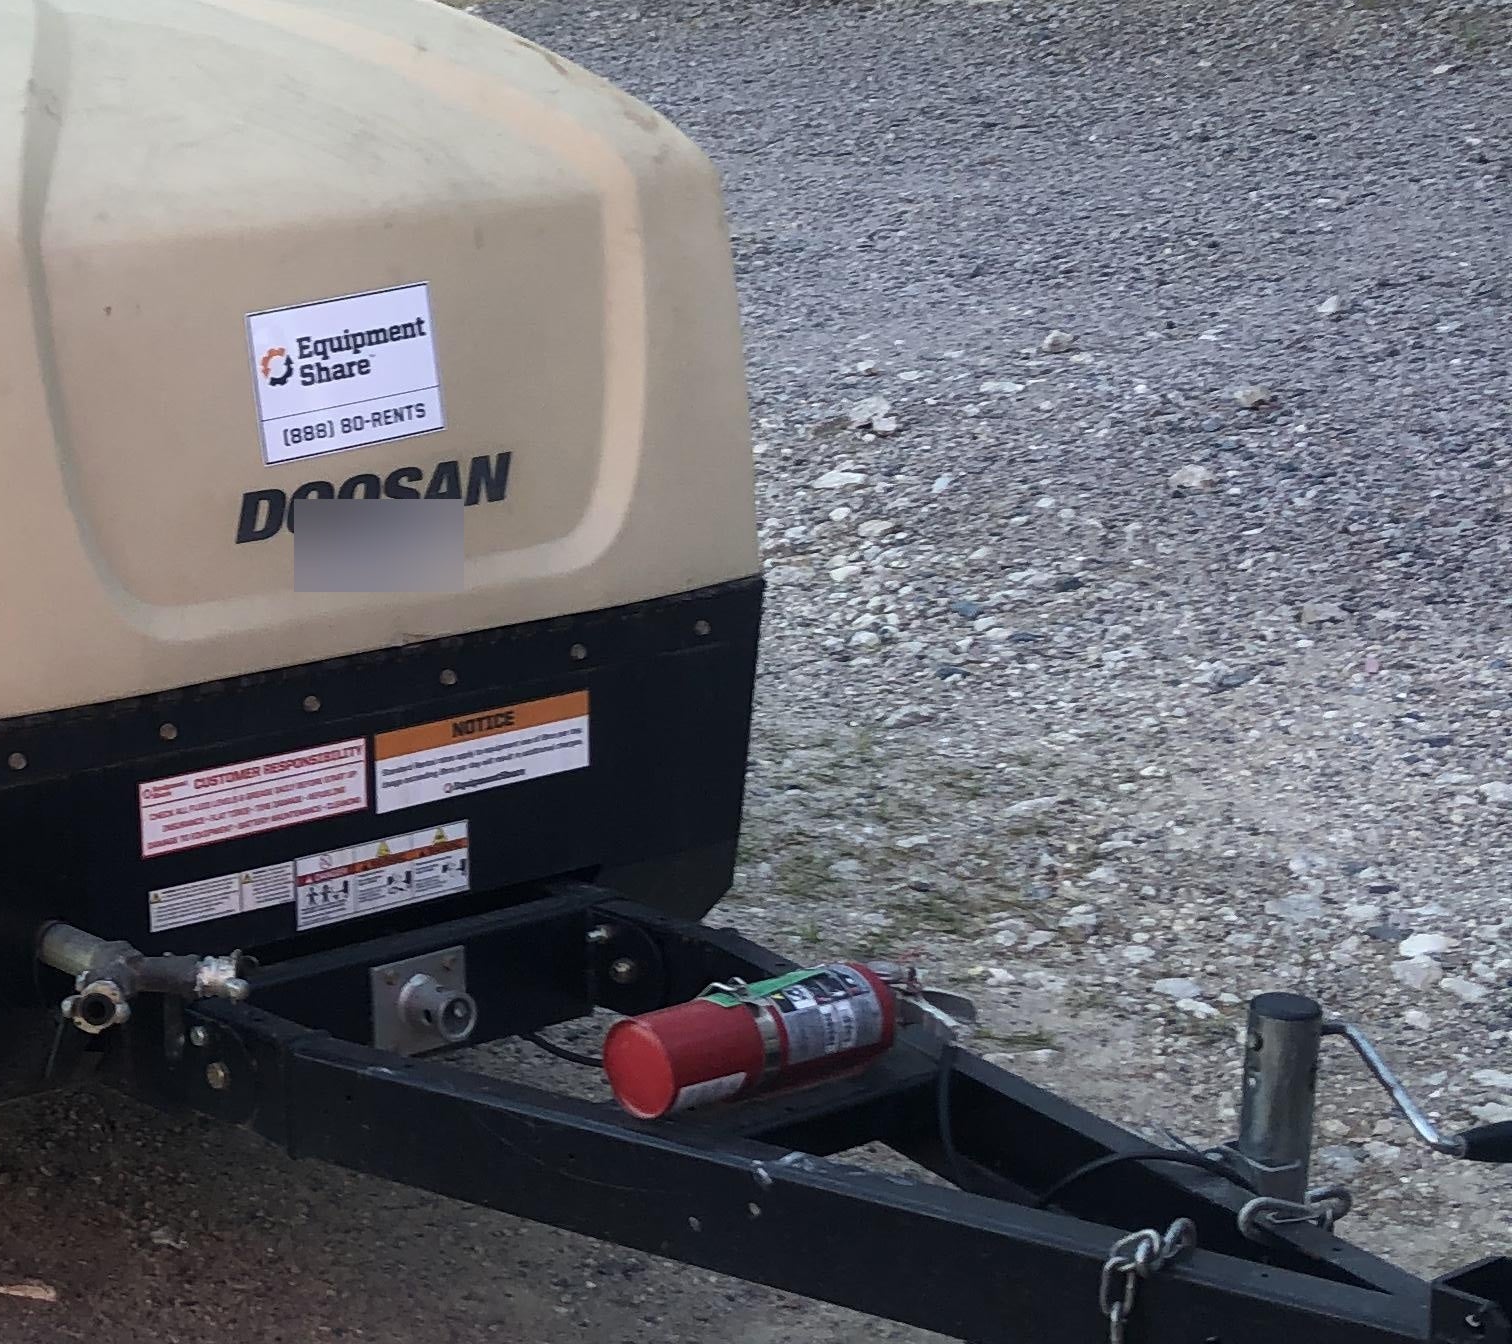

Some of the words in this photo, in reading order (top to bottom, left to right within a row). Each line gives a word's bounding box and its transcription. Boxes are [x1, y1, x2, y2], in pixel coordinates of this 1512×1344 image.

[296, 317, 426, 360] Equipment
[300, 357, 372, 386] Share
[282, 420, 335, 446] (888)
[340, 402, 426, 434] 80-RENTS
[452, 711, 516, 738] NOTICE
[194, 766, 260, 789] CUSTOMER
[264, 745, 361, 774] RESPONSIBILITY
